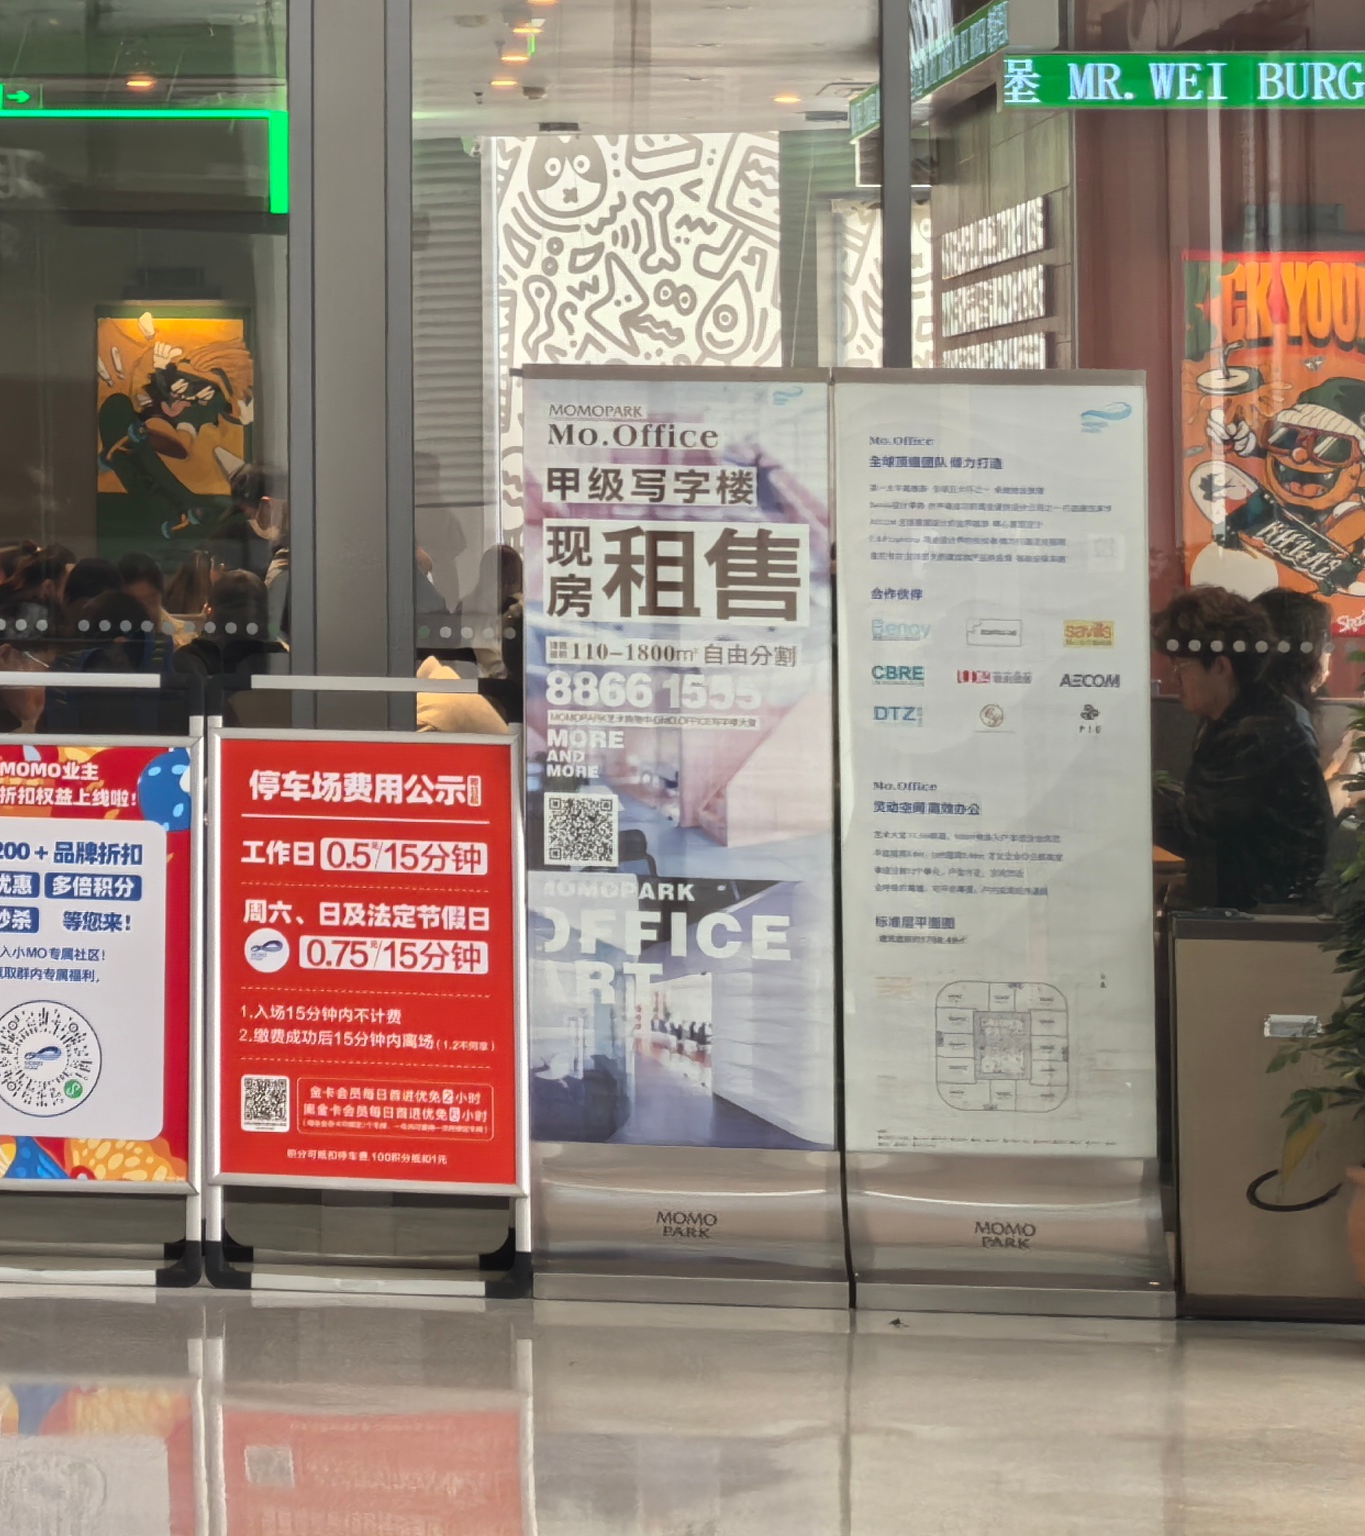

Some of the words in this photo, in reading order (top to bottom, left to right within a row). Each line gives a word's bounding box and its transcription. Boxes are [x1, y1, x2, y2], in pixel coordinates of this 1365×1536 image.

[1067, 62, 1134, 100] MR.
[1149, 62, 1228, 100] WEI
[549, 404, 643, 418] MOMOPARK
[548, 423, 719, 448] Mo.Office
[546, 467, 754, 505] 甲级写字楼
[546, 526, 593, 618] 现房
[602, 525, 801, 621] 租售
[704, 643, 797, 667] 自由分割
[871, 665, 925, 681] CBRE
[1060, 674, 1121, 688] AECOM
[546, 670, 653, 708] 8866
[873, 705, 917, 721] DTZ
[547, 730, 625, 749] MORE
[547, 750, 585, 763] AND
[0, 761, 100, 781] MOMO业主
[546, 765, 599, 778] MORE
[250, 769, 466, 805] 停车场费用公示
[240, 840, 315, 866] 工作日
[52, 875, 134, 898] 多倍积分
[243, 899, 490, 931] 周六、日及法定节假日
[656, 1211, 718, 1227] MOMO
[974, 1221, 1037, 1237] MOMO
